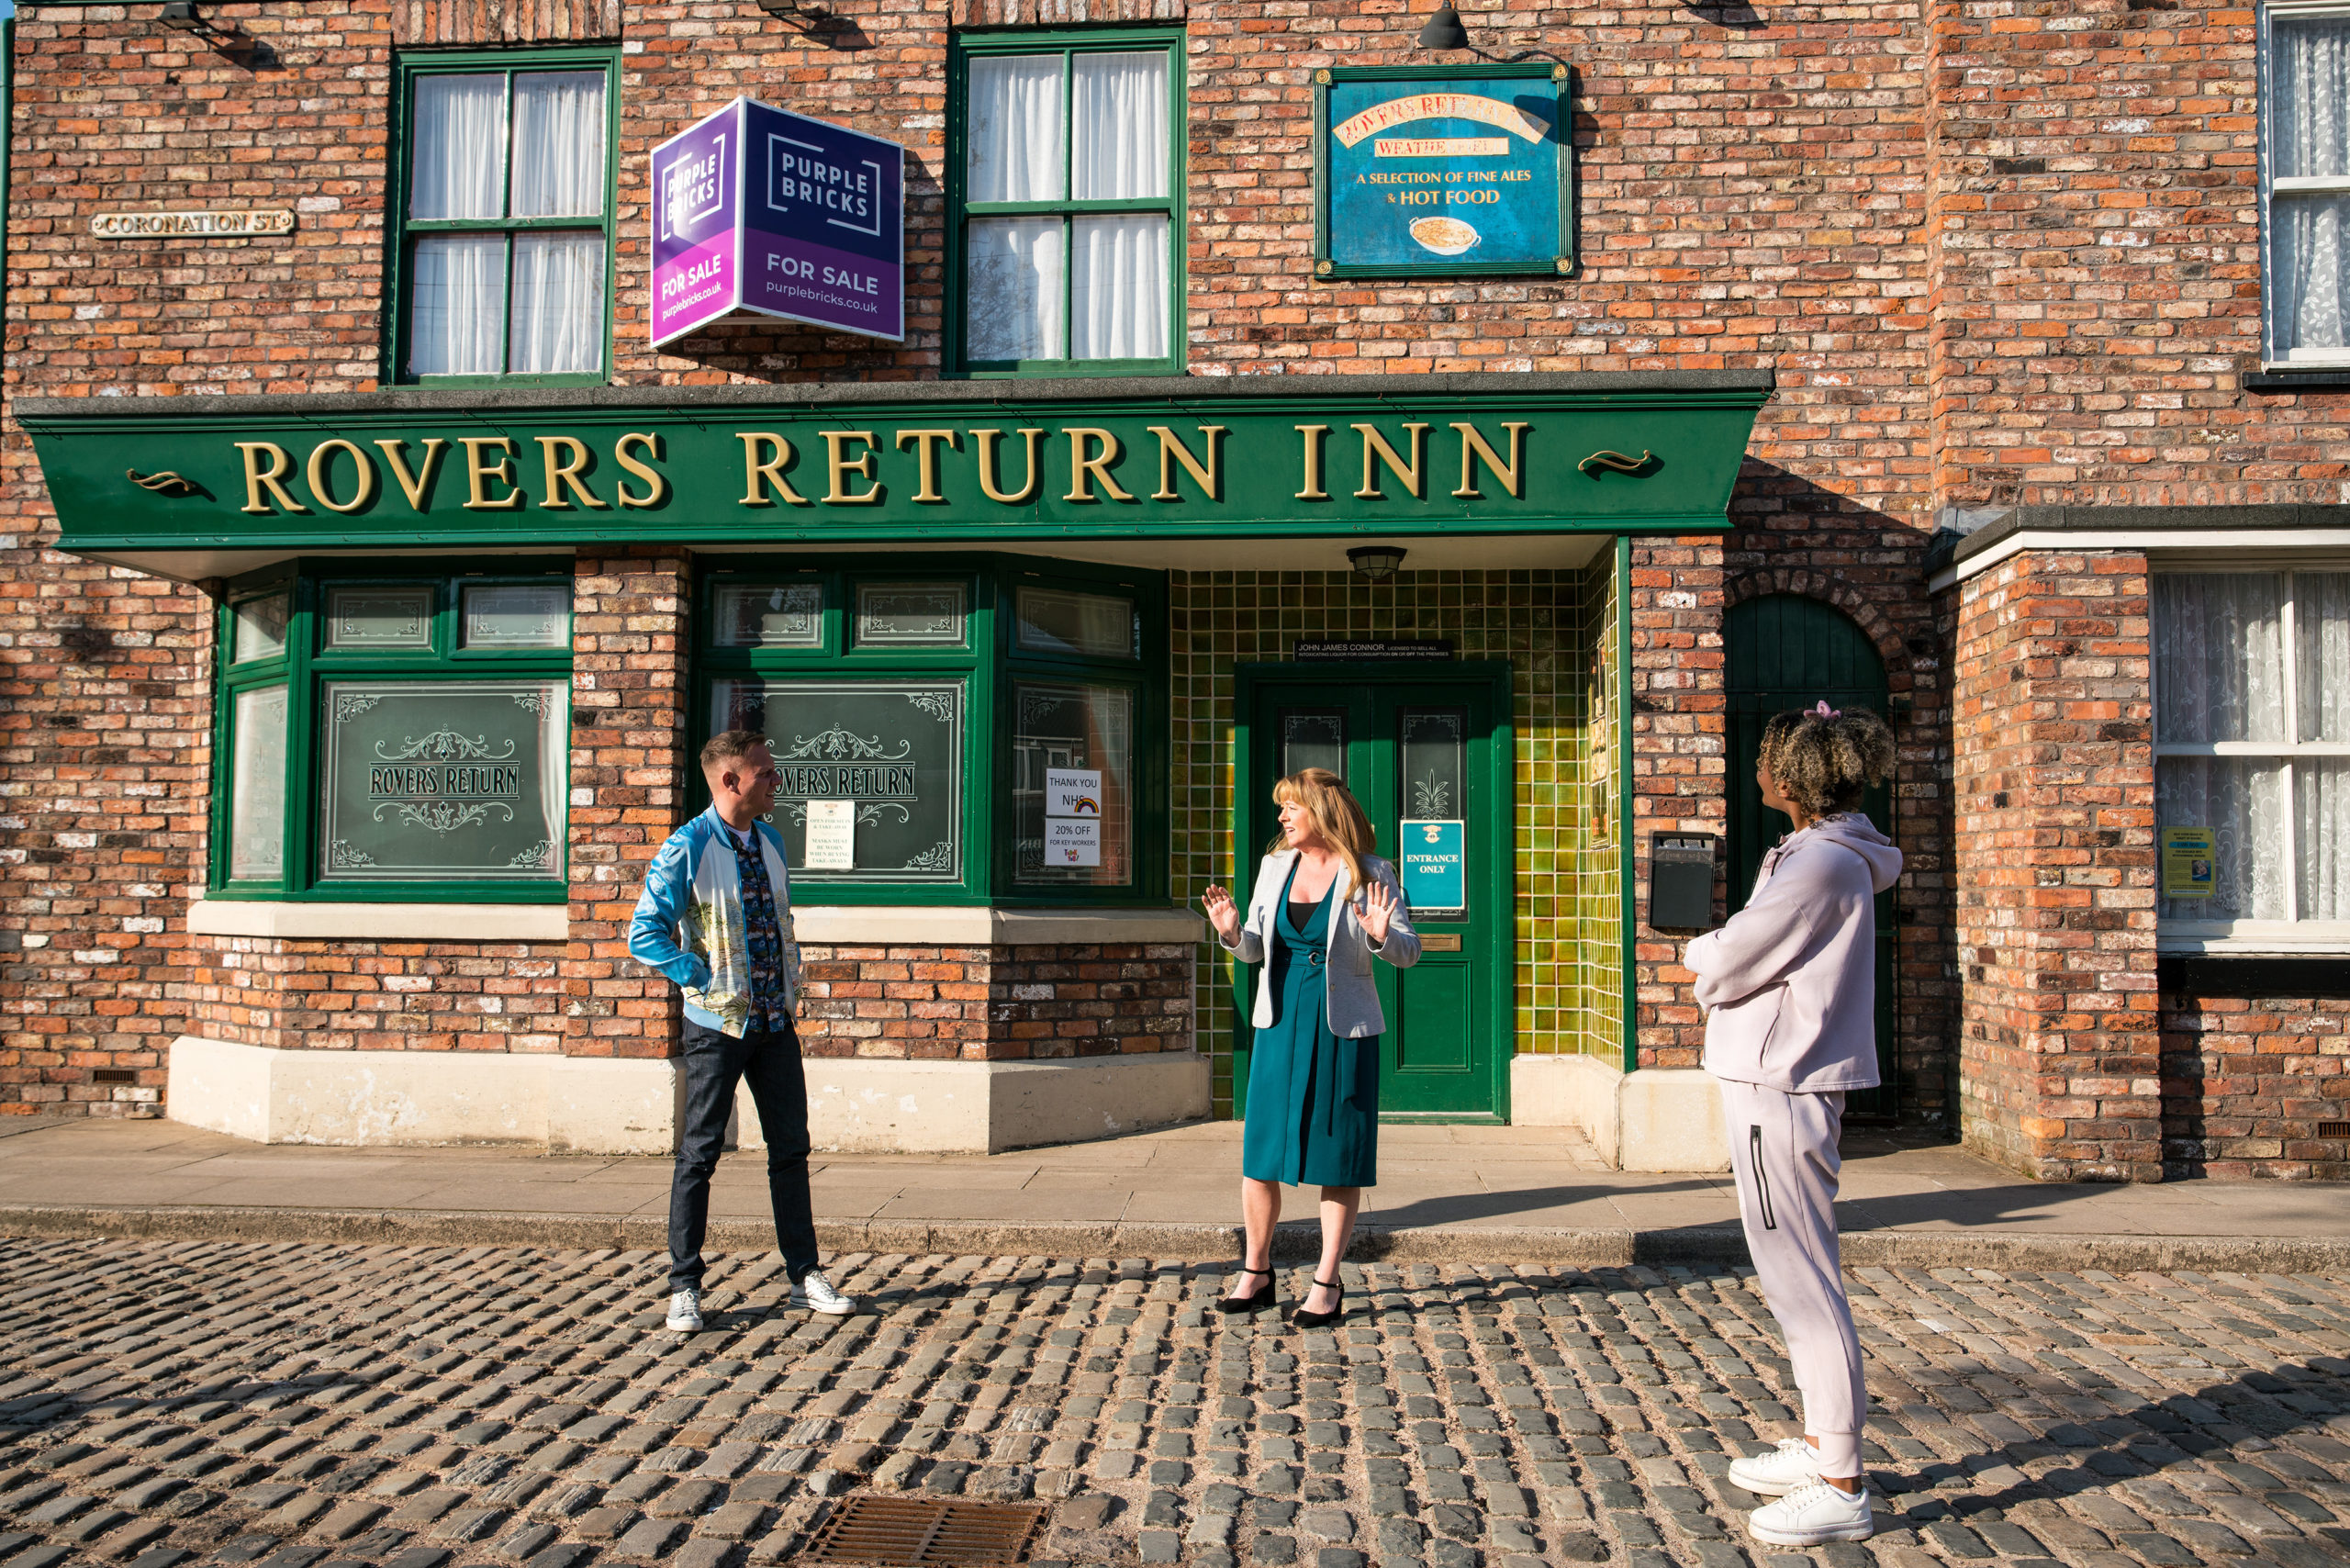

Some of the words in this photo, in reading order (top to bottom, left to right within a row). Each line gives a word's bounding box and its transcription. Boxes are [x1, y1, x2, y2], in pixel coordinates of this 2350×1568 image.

[1338, 98, 1416, 144] ROVERS
[668, 153, 716, 198] PURPLE
[782, 152, 867, 194] PURPLE
[1356, 174, 1366, 185] A
[1370, 172, 1441, 184] SELECTION
[1445, 172, 1464, 183] OF
[1468, 171, 1497, 183] FINE
[1500, 170, 1531, 182] ALES
[667, 179, 714, 221] BRICKS
[782, 177, 867, 217] BRICKS
[1387, 193, 1395, 203] &
[1400, 191, 1441, 205] HOT
[1446, 189, 1500, 205] FOOD
[103, 214, 247, 234] CORONATION
[253, 215, 281, 230] ST.
[662, 275, 685, 301] FOR
[688, 254, 722, 287] SALE
[767, 252, 814, 280] FOR
[822, 266, 878, 295] SALE
[663, 281, 722, 322] purplebricks.co.uk
[767, 281, 878, 314] purplebricks.co.uk
[234, 431, 665, 512] ROVERS
[735, 425, 1226, 505] RETURN
[1294, 421, 1529, 498] INN
[1298, 644, 1320, 652] JOHN
[370, 767, 438, 794] ROVERS
[443, 767, 520, 794] RETURN
[774, 767, 831, 795] OVERS
[836, 767, 915, 795] RETURN
[1049, 778, 1078, 788] THANK
[1080, 778, 1098, 788] YOU
[1062, 794, 1086, 806] NHS
[1056, 825, 1073, 835] 20%
[1074, 825, 1091, 835] OFF
[1406, 854, 1459, 863] ENTRANCE
[1419, 865, 1446, 874] ONLY
